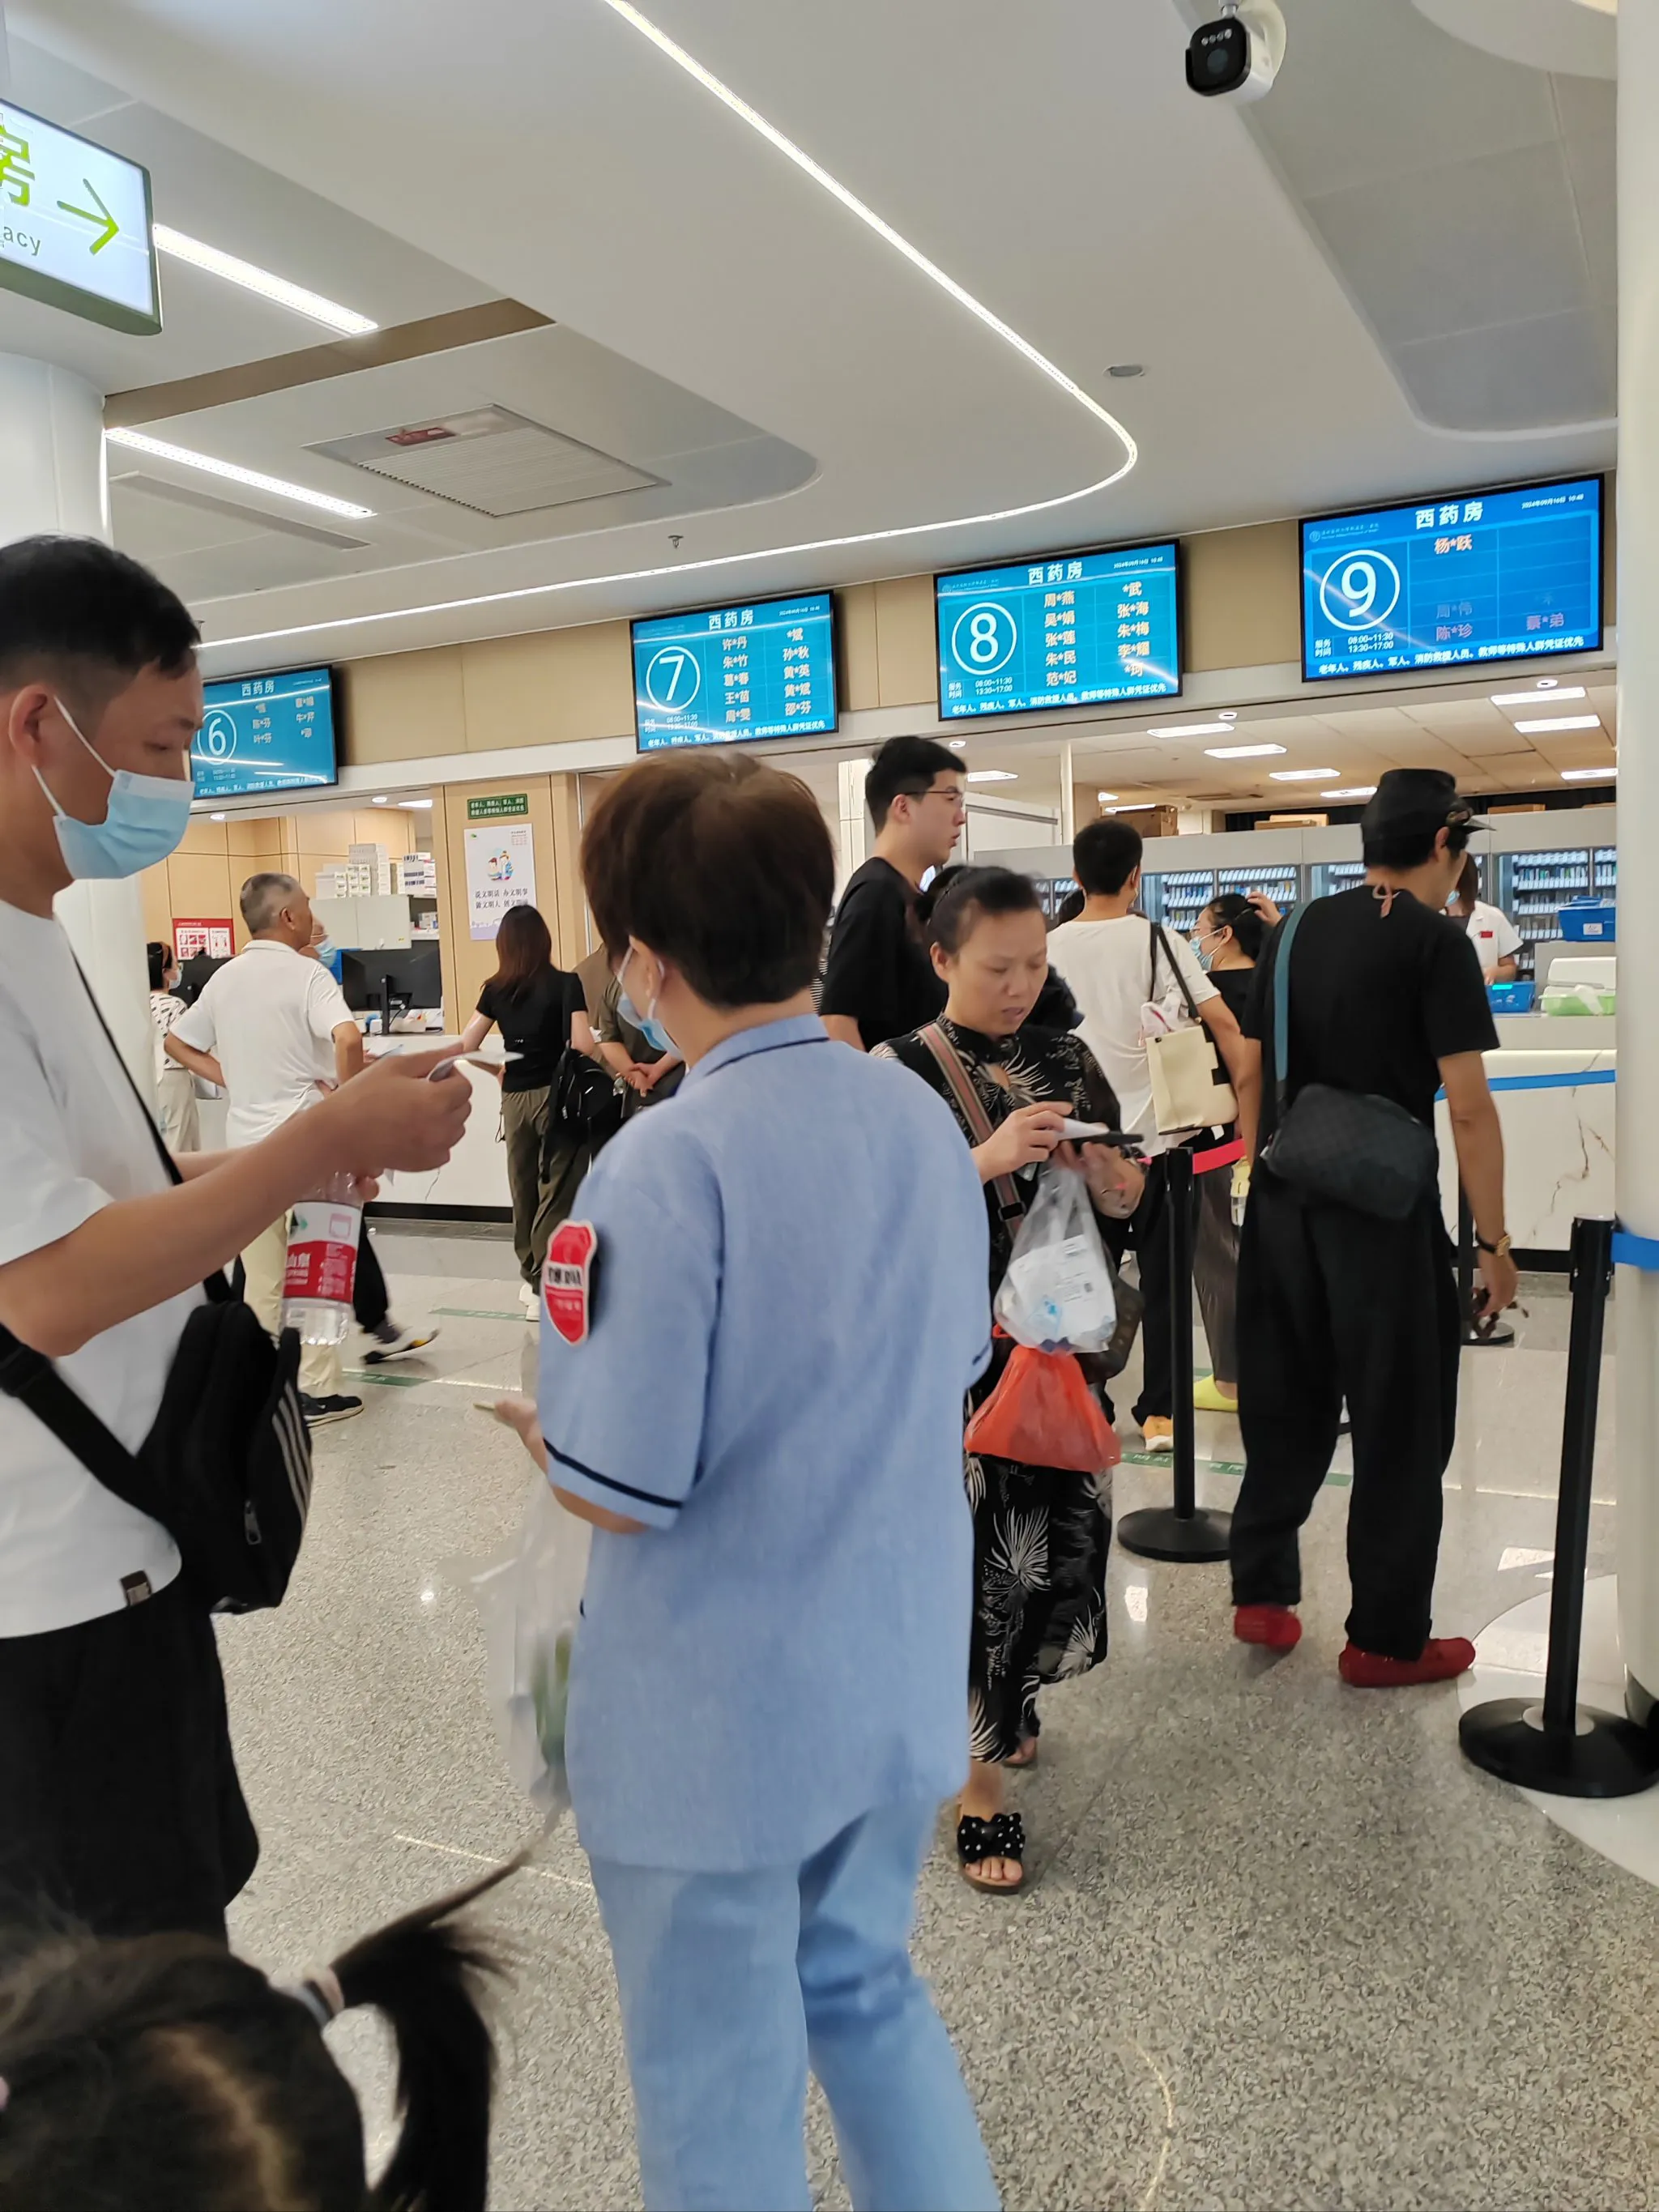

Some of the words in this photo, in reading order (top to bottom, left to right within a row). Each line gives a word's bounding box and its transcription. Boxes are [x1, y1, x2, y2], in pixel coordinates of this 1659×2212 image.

[0, 225, 41, 257] acy
[1415, 501, 1483, 530] 西药房
[1028, 561, 1082, 586] 西药房
[1341, 561, 1376, 617] 9
[709, 609, 753, 631] 西药房
[970, 612, 999, 663] 8
[241, 680, 275, 697] 西药房
[659, 654, 684, 701] 7
[208, 717, 227, 756] 6
